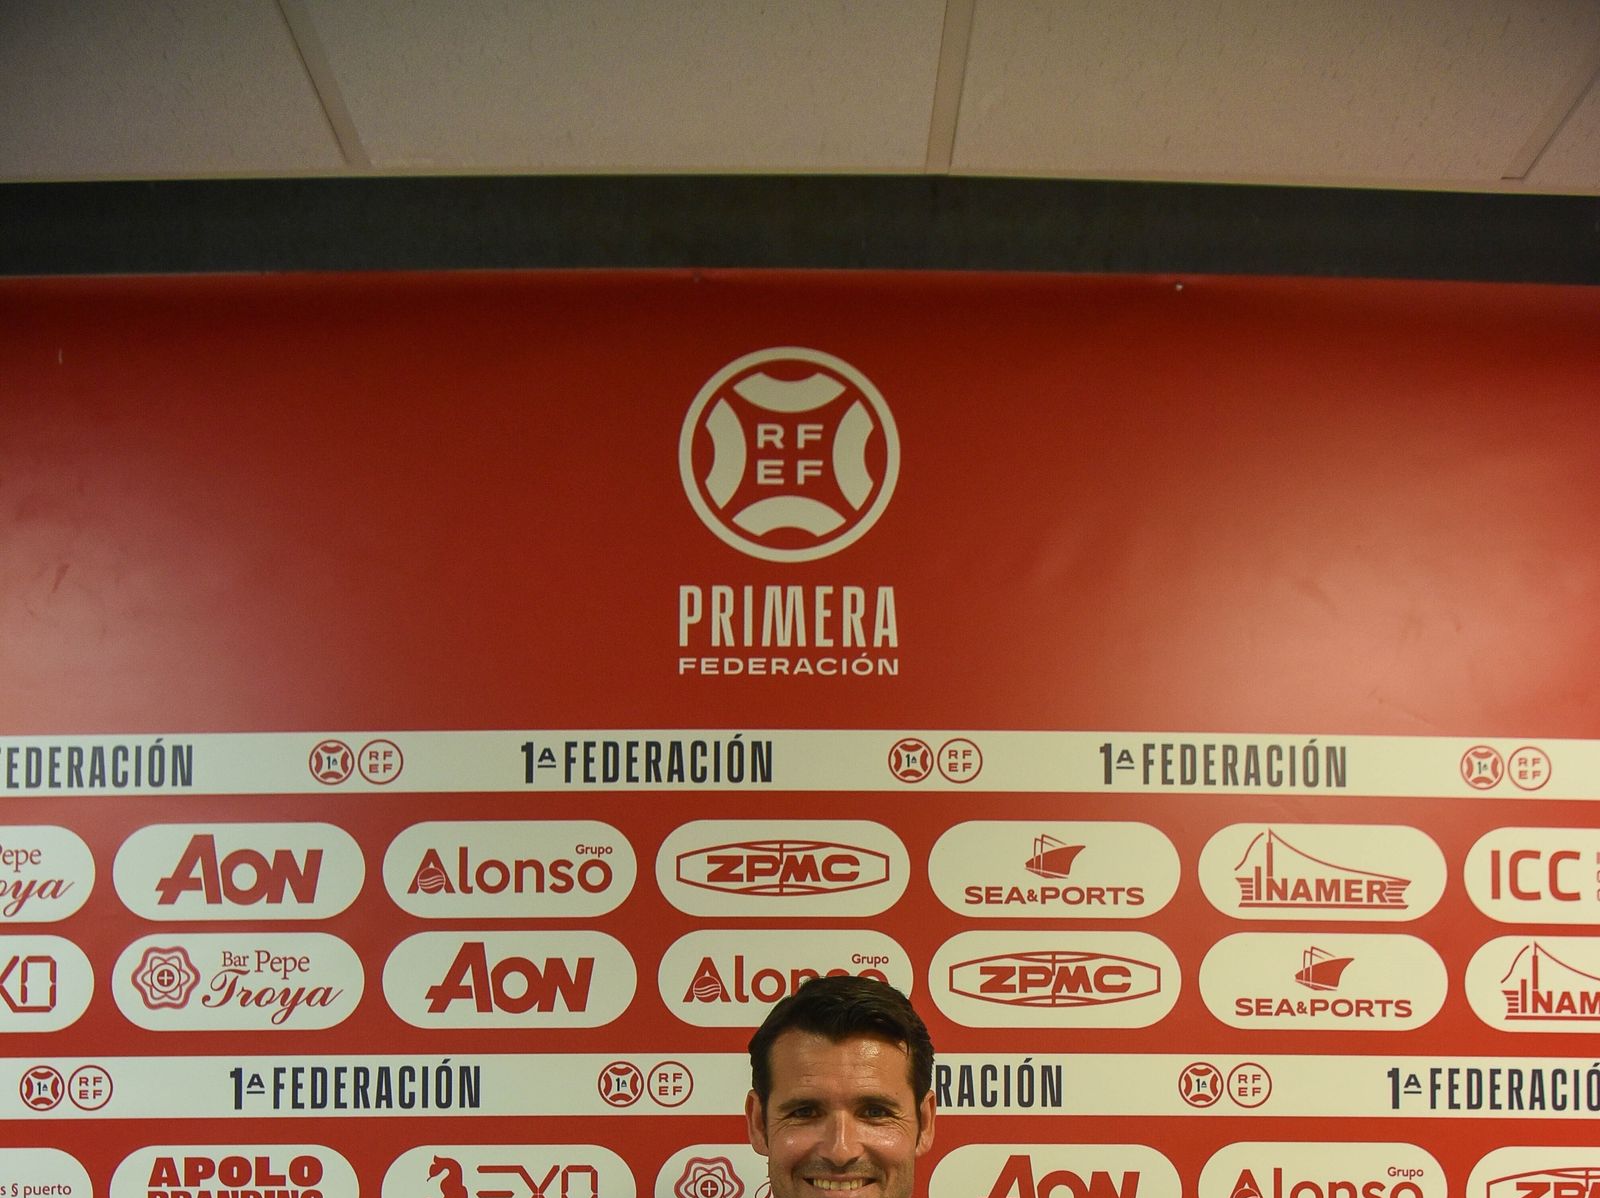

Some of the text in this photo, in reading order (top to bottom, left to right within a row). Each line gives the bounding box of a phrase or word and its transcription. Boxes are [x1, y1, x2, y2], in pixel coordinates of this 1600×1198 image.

[680, 586, 898, 647] PRIMERA
[679, 653, 898, 675] FEDERACIÓN
[0, 738, 193, 788] EDERACIÓN
[565, 734, 772, 783] FEDERACIÓN
[1143, 739, 1346, 787] FEDERACIÓN
[156, 834, 323, 905] AON
[407, 846, 613, 894] Alonso
[576, 844, 612, 857] Grupo
[707, 855, 860, 883] ZPMC
[965, 886, 1144, 905] SEA&PORTS
[1491, 850, 1581, 901] ICC
[223, 950, 310, 979] Bar Pepe
[425, 942, 594, 1014] AON
[851, 953, 889, 967] Grupo
[980, 965, 1132, 993] ZPMC
[202, 972, 344, 1025] Troya
[1236, 998, 1412, 1018] SEA&PORTS
[1520, 978, 1600, 1015] INAM
[273, 1059, 480, 1109] FEDERACIÓN
[935, 1058, 1062, 1108] RACIÓN
[1430, 1063, 1600, 1111] FEDERACIÓ
[24, 1184, 71, 1198] puerto
[148, 1156, 323, 1187] APOLO
[1388, 1167, 1423, 1180] Grupo
